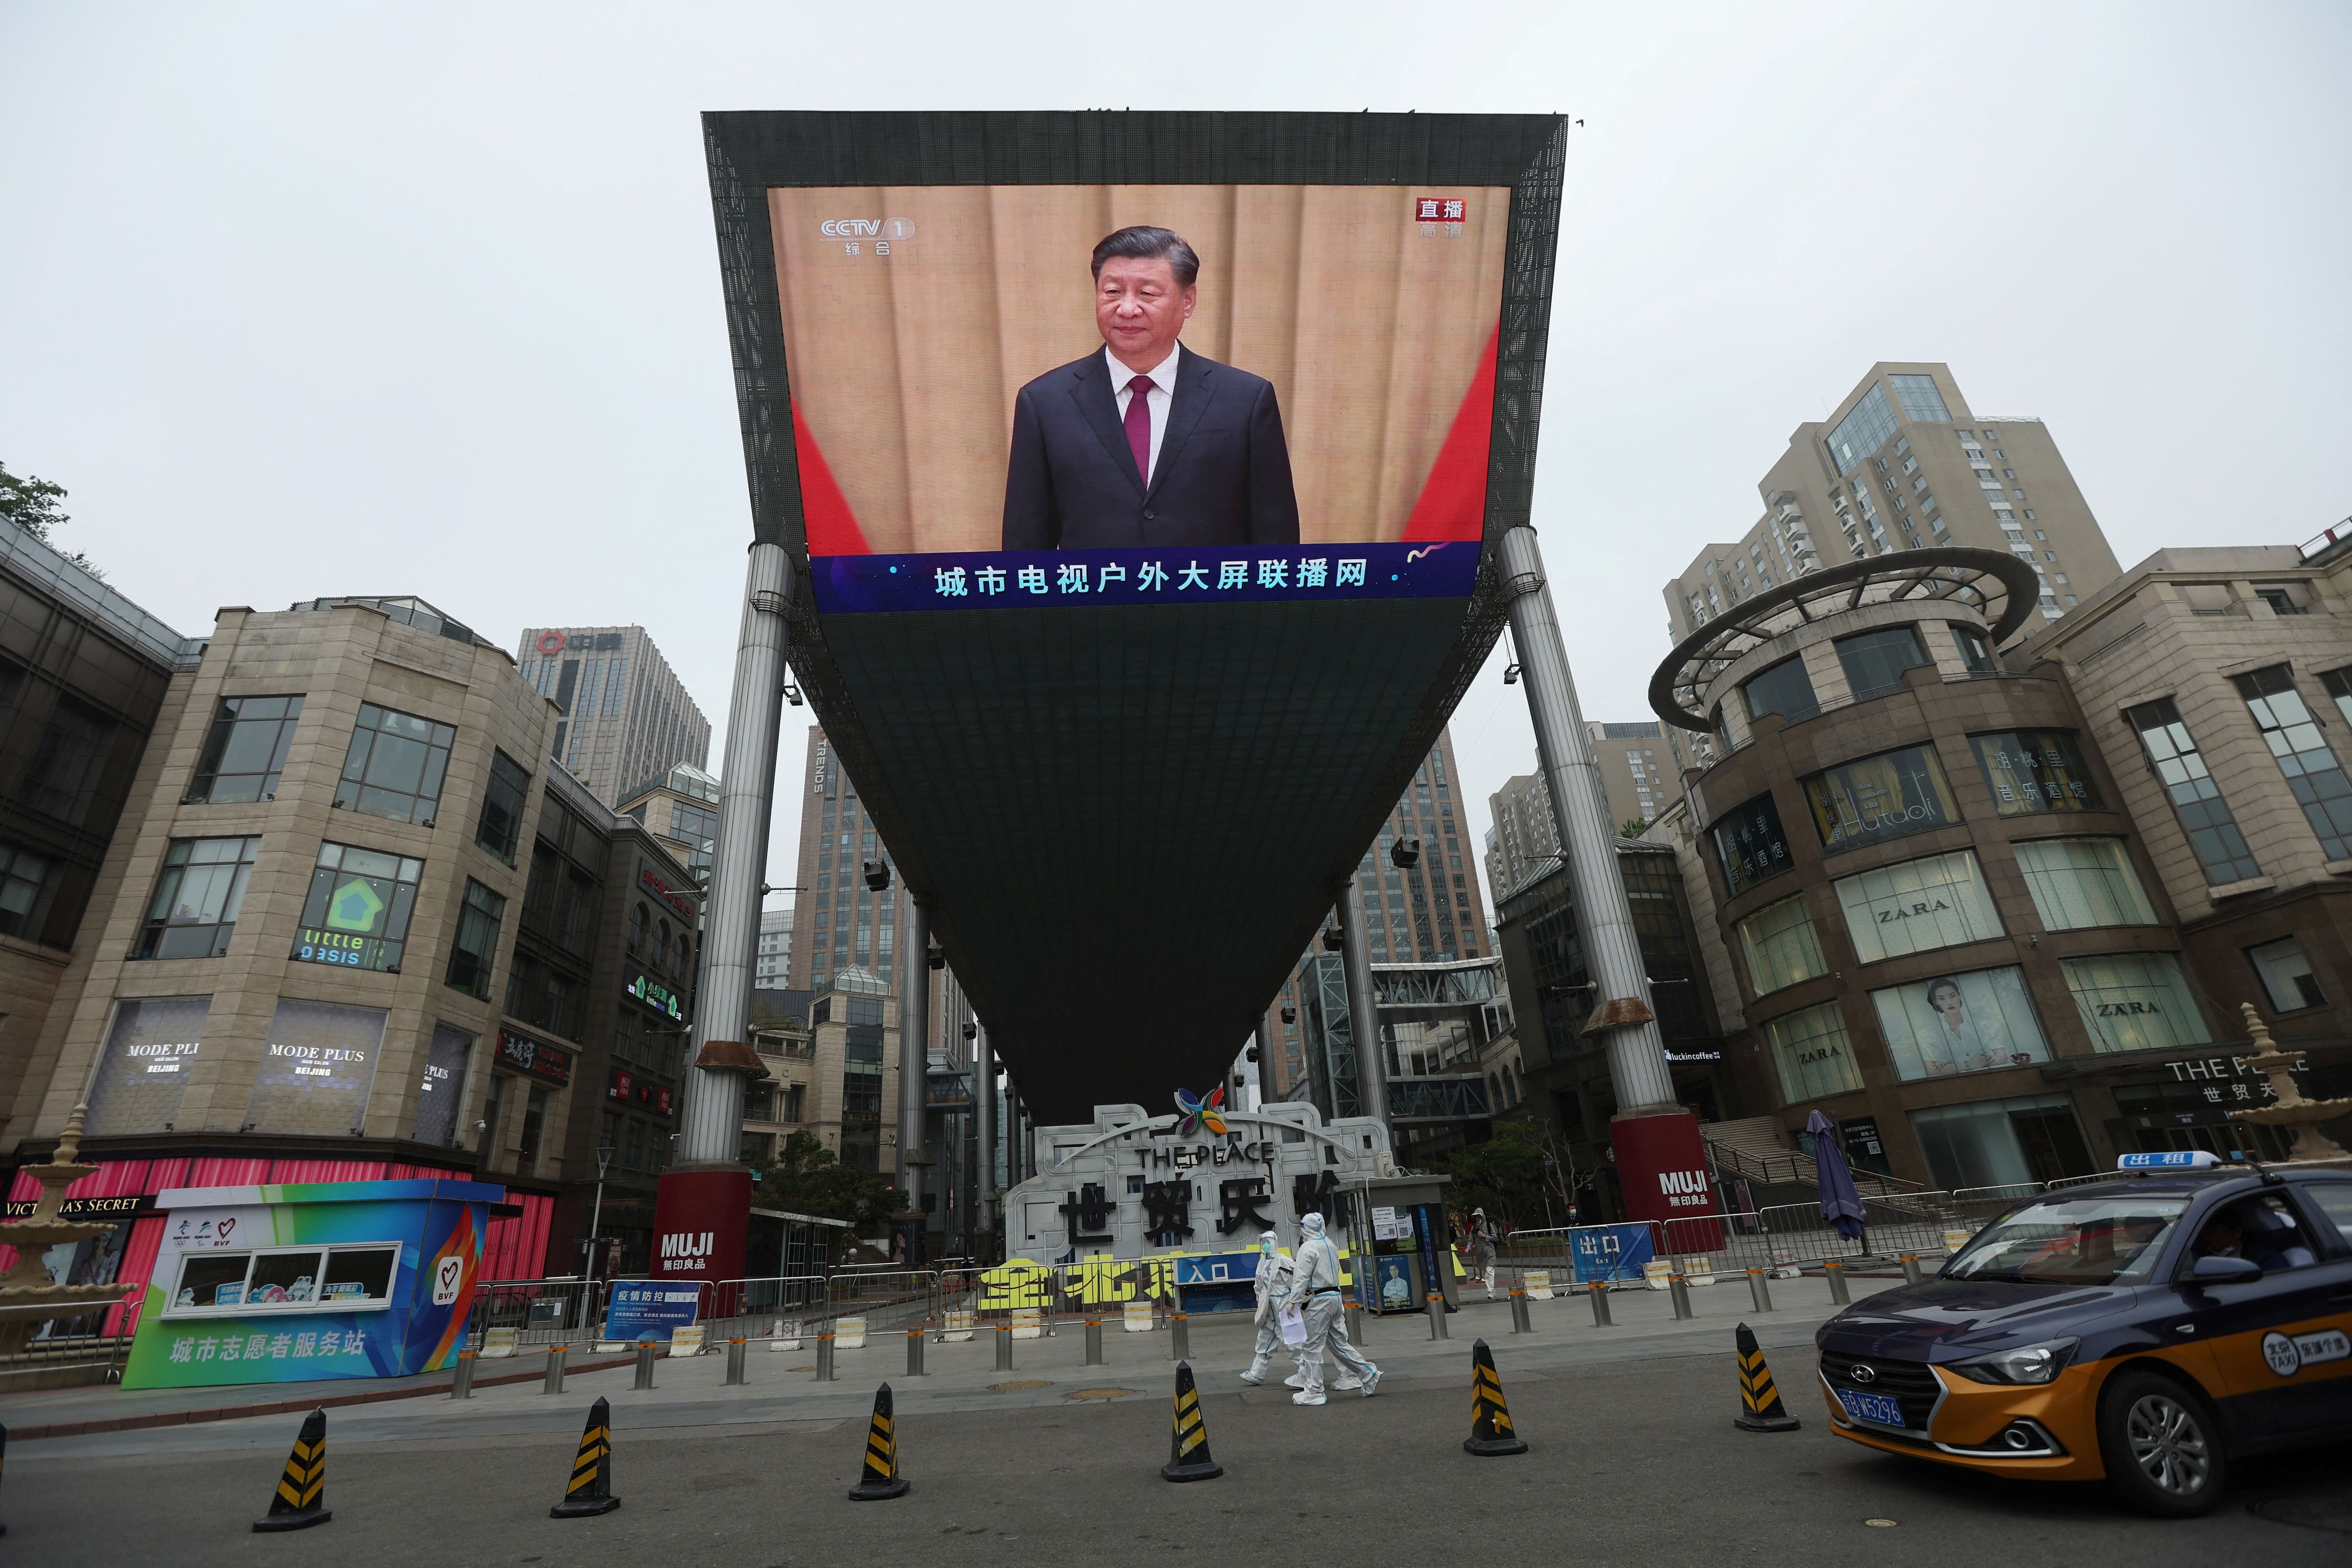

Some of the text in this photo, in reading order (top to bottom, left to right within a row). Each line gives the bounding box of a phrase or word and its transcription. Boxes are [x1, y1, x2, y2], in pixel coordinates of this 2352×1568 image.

[1420, 199, 1463, 218] 直播
[821, 219, 901, 237] CCTV 1
[1419, 220, 1463, 239] 高清
[845, 241, 890, 256] 综合
[934, 557, 1369, 597] 城市电视户外大屏联播网
[568, 633, 622, 650] 中骏
[813, 739, 827, 794] TRENDS
[1998, 780, 2087, 801] 音乐酒馆
[1730, 842, 1784, 883] 音乐酒馆
[1878, 899, 1949, 923] ZARA
[304, 929, 363, 949] little
[301, 946, 359, 964] oasis
[2096, 1001, 2161, 1018] ZARA
[126, 1043, 199, 1057] MODE PL
[269, 1044, 364, 1062] MODE PLUS
[1799, 1045, 1841, 1067] ZARA
[147, 1065, 180, 1073] BEIJING
[295, 1067, 331, 1076] BEIJING
[429, 1066, 448, 1080] PLUS
[2165, 1059, 2228, 1081] THE
[2203, 1083, 2299, 1102] 世贸天
[1135, 1142, 1275, 1168] THE PLACE
[2130, 1154, 2185, 1165] 出租
[1659, 1170, 1708, 1194] MUJI
[7, 1198, 140, 1216] VICTIA'S SECRET
[1058, 1170, 1348, 1245] 世贸天阶
[1669, 1194, 1708, 1207] 無印良品
[661, 1232, 714, 1258] MUJI
[1580, 1235, 1620, 1255] 出口
[663, 1258, 706, 1271] 無印良品
[1188, 1263, 1229, 1282] 入口
[324, 1284, 358, 1293] 为冬奥喝彩
[618, 1290, 664, 1302] 疫情防控
[169, 1329, 366, 1363] 城市志愿者服务站
[2267, 1340, 2291, 1355] 北京
[2270, 1353, 2296, 1369] TAXI
